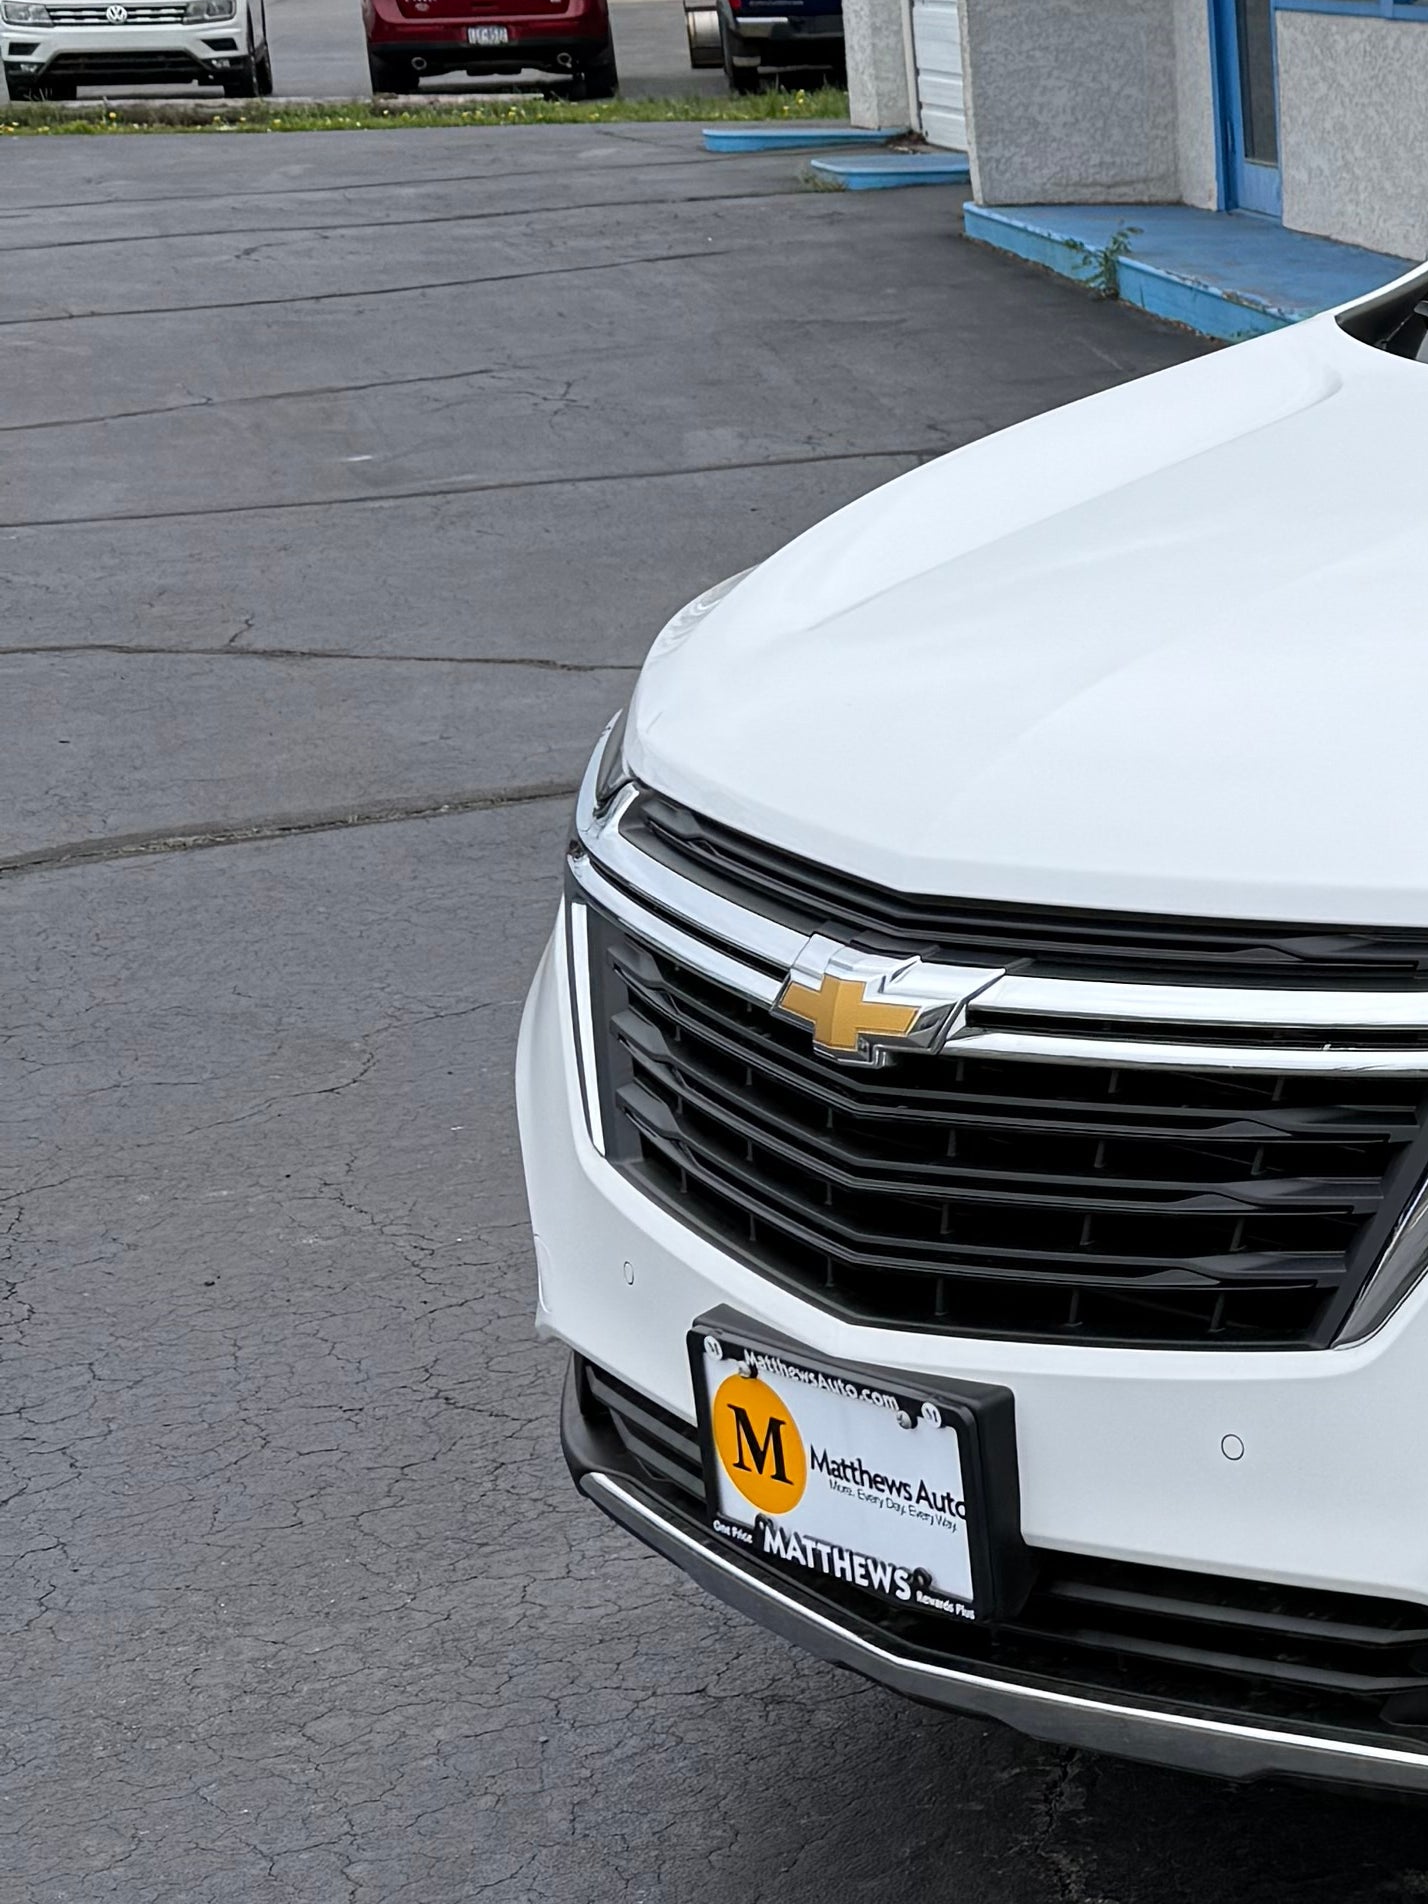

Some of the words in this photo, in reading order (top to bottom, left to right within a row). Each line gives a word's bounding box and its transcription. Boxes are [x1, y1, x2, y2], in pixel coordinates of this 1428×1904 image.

[744, 1349, 900, 1411] MatthewsAuto.com
[727, 1403, 795, 1486] M
[810, 1444, 913, 1502] Matthews
[916, 1479, 966, 1520] Auto
[763, 1524, 911, 1601] MATTHEWS
